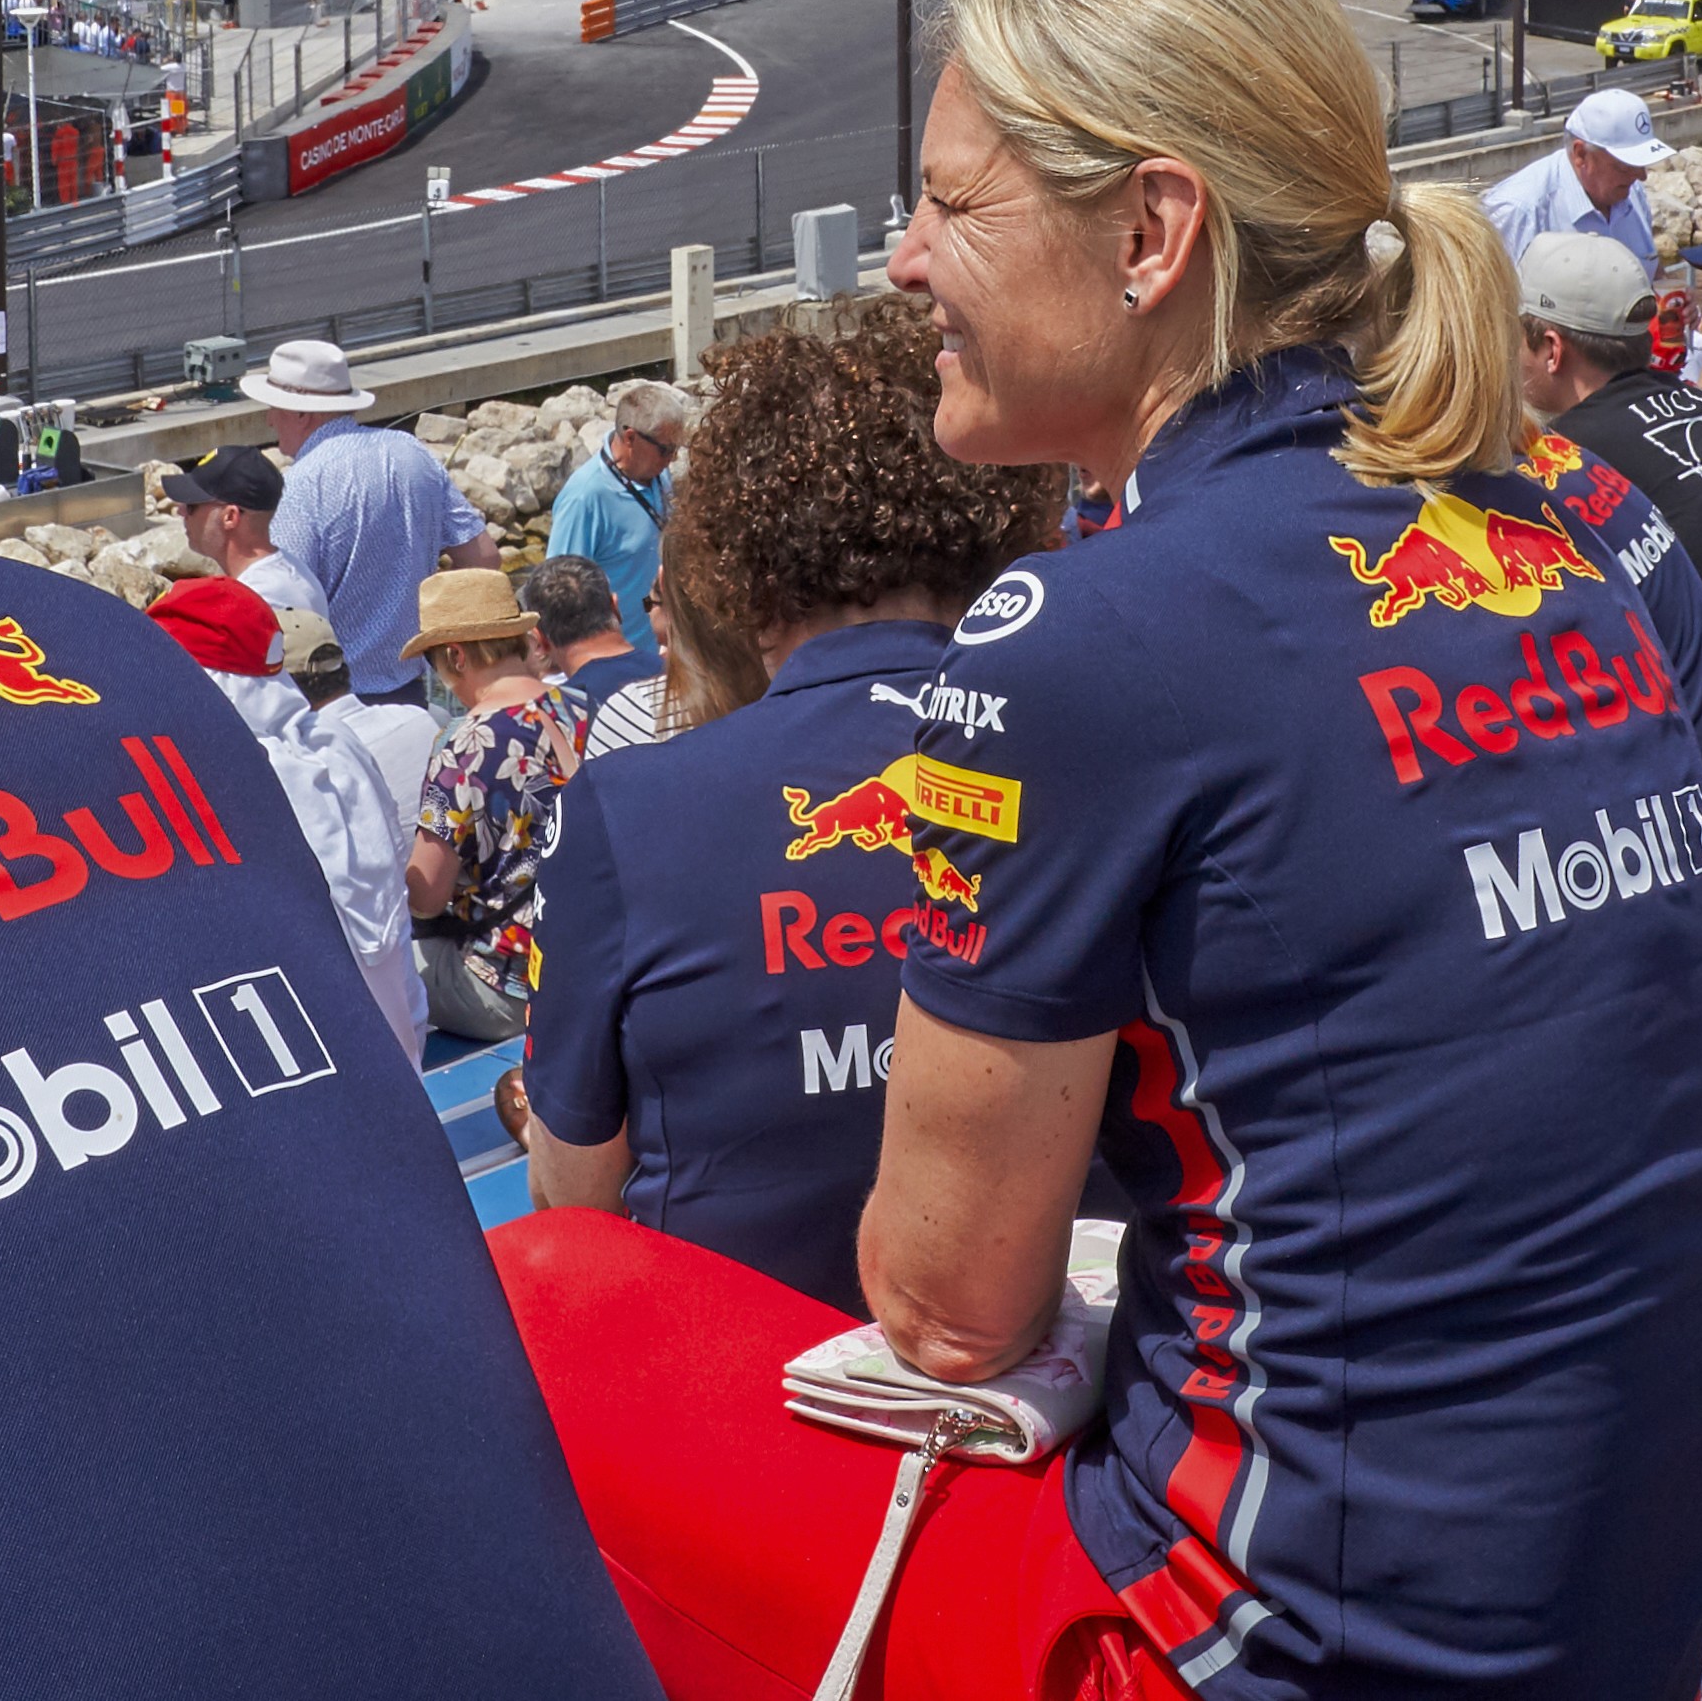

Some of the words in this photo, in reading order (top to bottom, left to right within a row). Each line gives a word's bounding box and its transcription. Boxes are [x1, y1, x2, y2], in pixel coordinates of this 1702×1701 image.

[300, 138, 332, 171] CASINO
[334, 132, 348, 153] DE
[348, 104, 406, 146] MONTE-CARLO
[1358, 632, 1576, 785] Red
[1463, 794, 1685, 940] Mobil
[928, 909, 988, 967] Bull
[1179, 1304, 1239, 1399] Red
